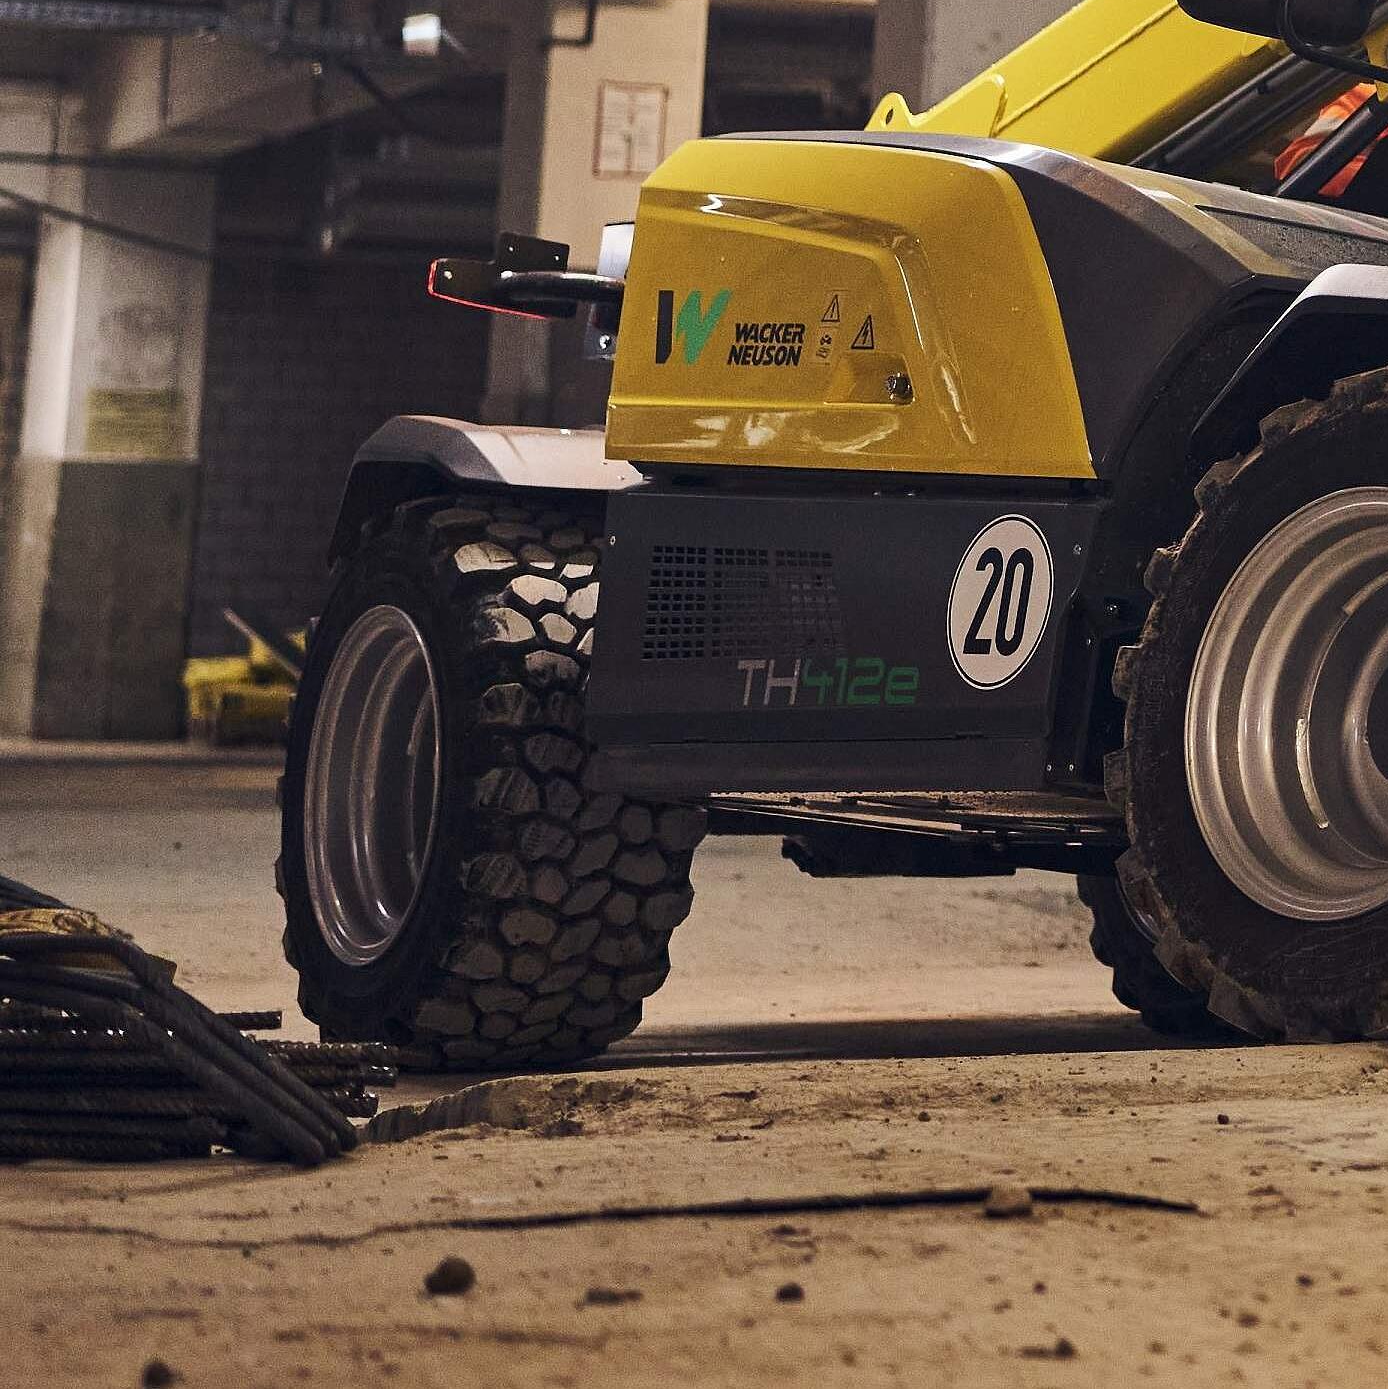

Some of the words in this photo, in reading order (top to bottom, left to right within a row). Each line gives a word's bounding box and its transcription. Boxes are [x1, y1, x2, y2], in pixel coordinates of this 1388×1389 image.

[735, 322, 806, 345] WACKER
[726, 344, 803, 367] NEUSON
[962, 546, 1035, 657] 20
[737, 658, 920, 707] TH412e
